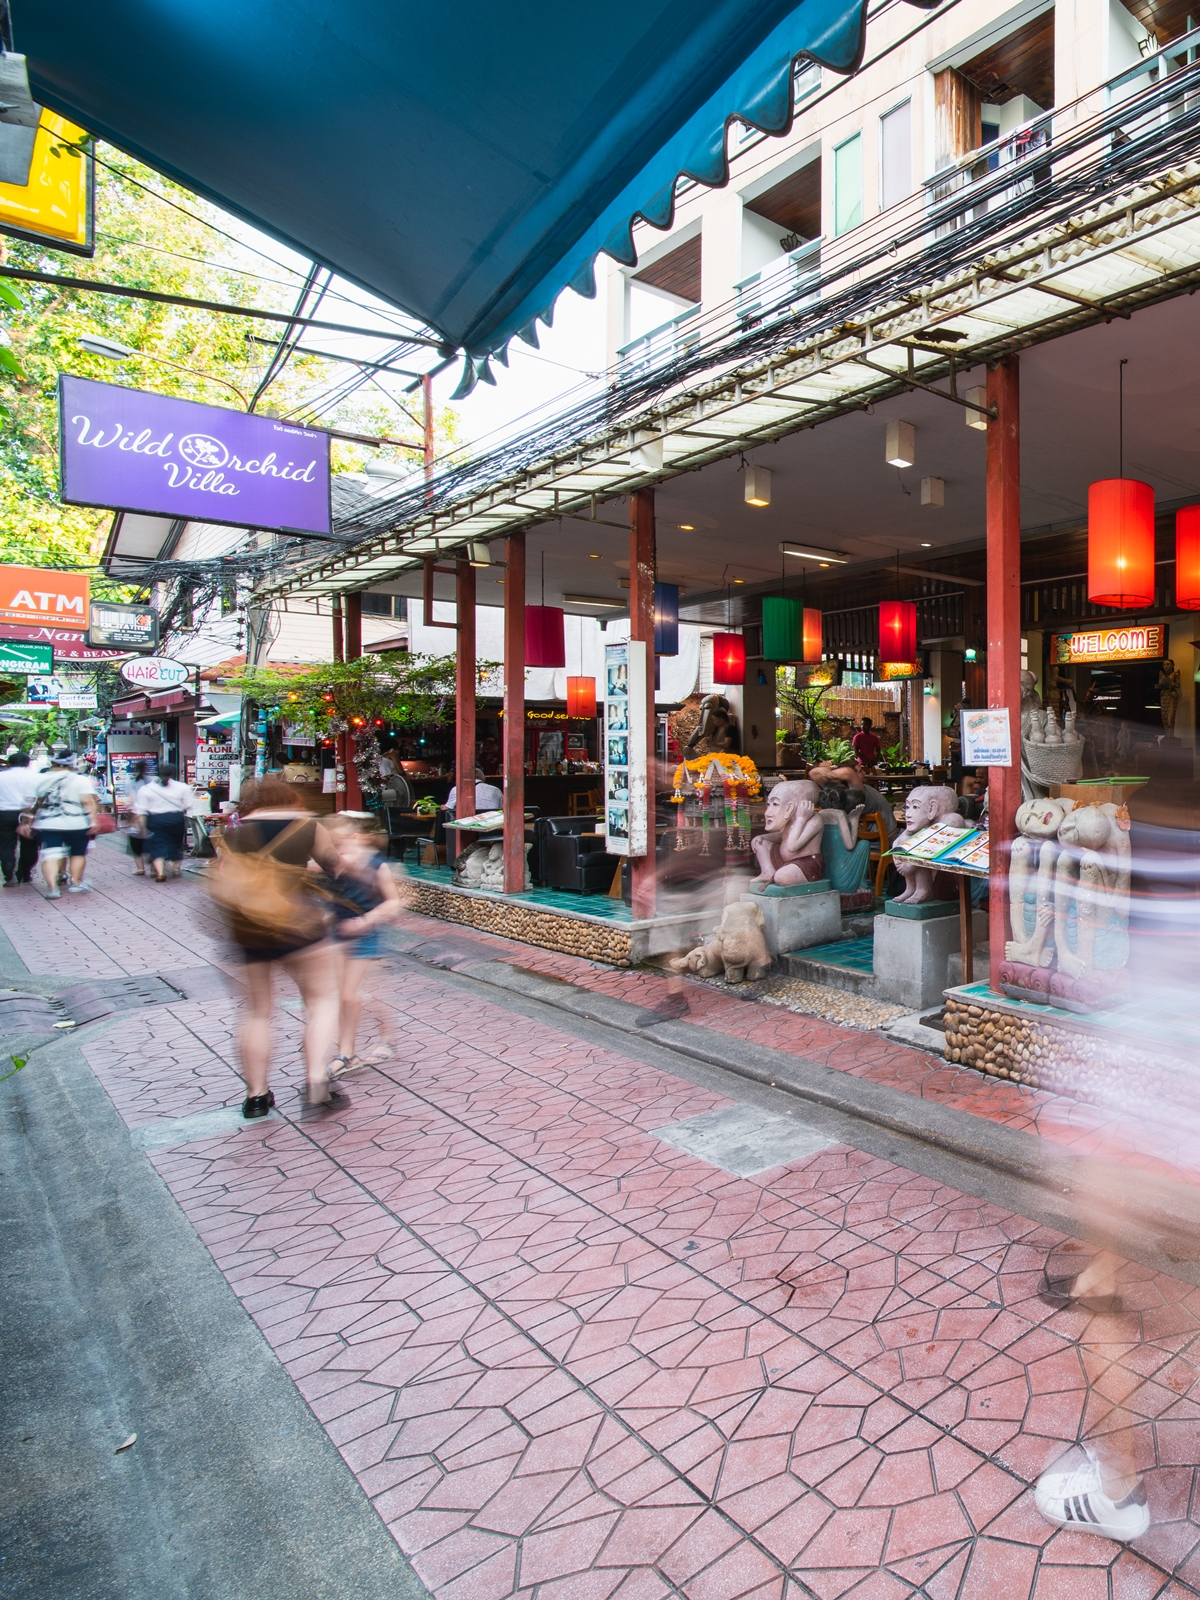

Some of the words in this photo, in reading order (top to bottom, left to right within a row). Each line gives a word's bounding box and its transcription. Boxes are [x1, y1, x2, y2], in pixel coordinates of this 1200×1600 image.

[71, 415, 174, 457] Wild
[178, 433, 317, 483] Orchid
[163, 462, 240, 496] Villa
[10, 590, 84, 614] ATM
[69, 650, 79, 658] &
[83, 648, 122, 658] BEAU
[1071, 627, 1160, 656] WELCOME
[1139, 649, 1159, 657] Service
[160, 668, 184, 682] CUT
